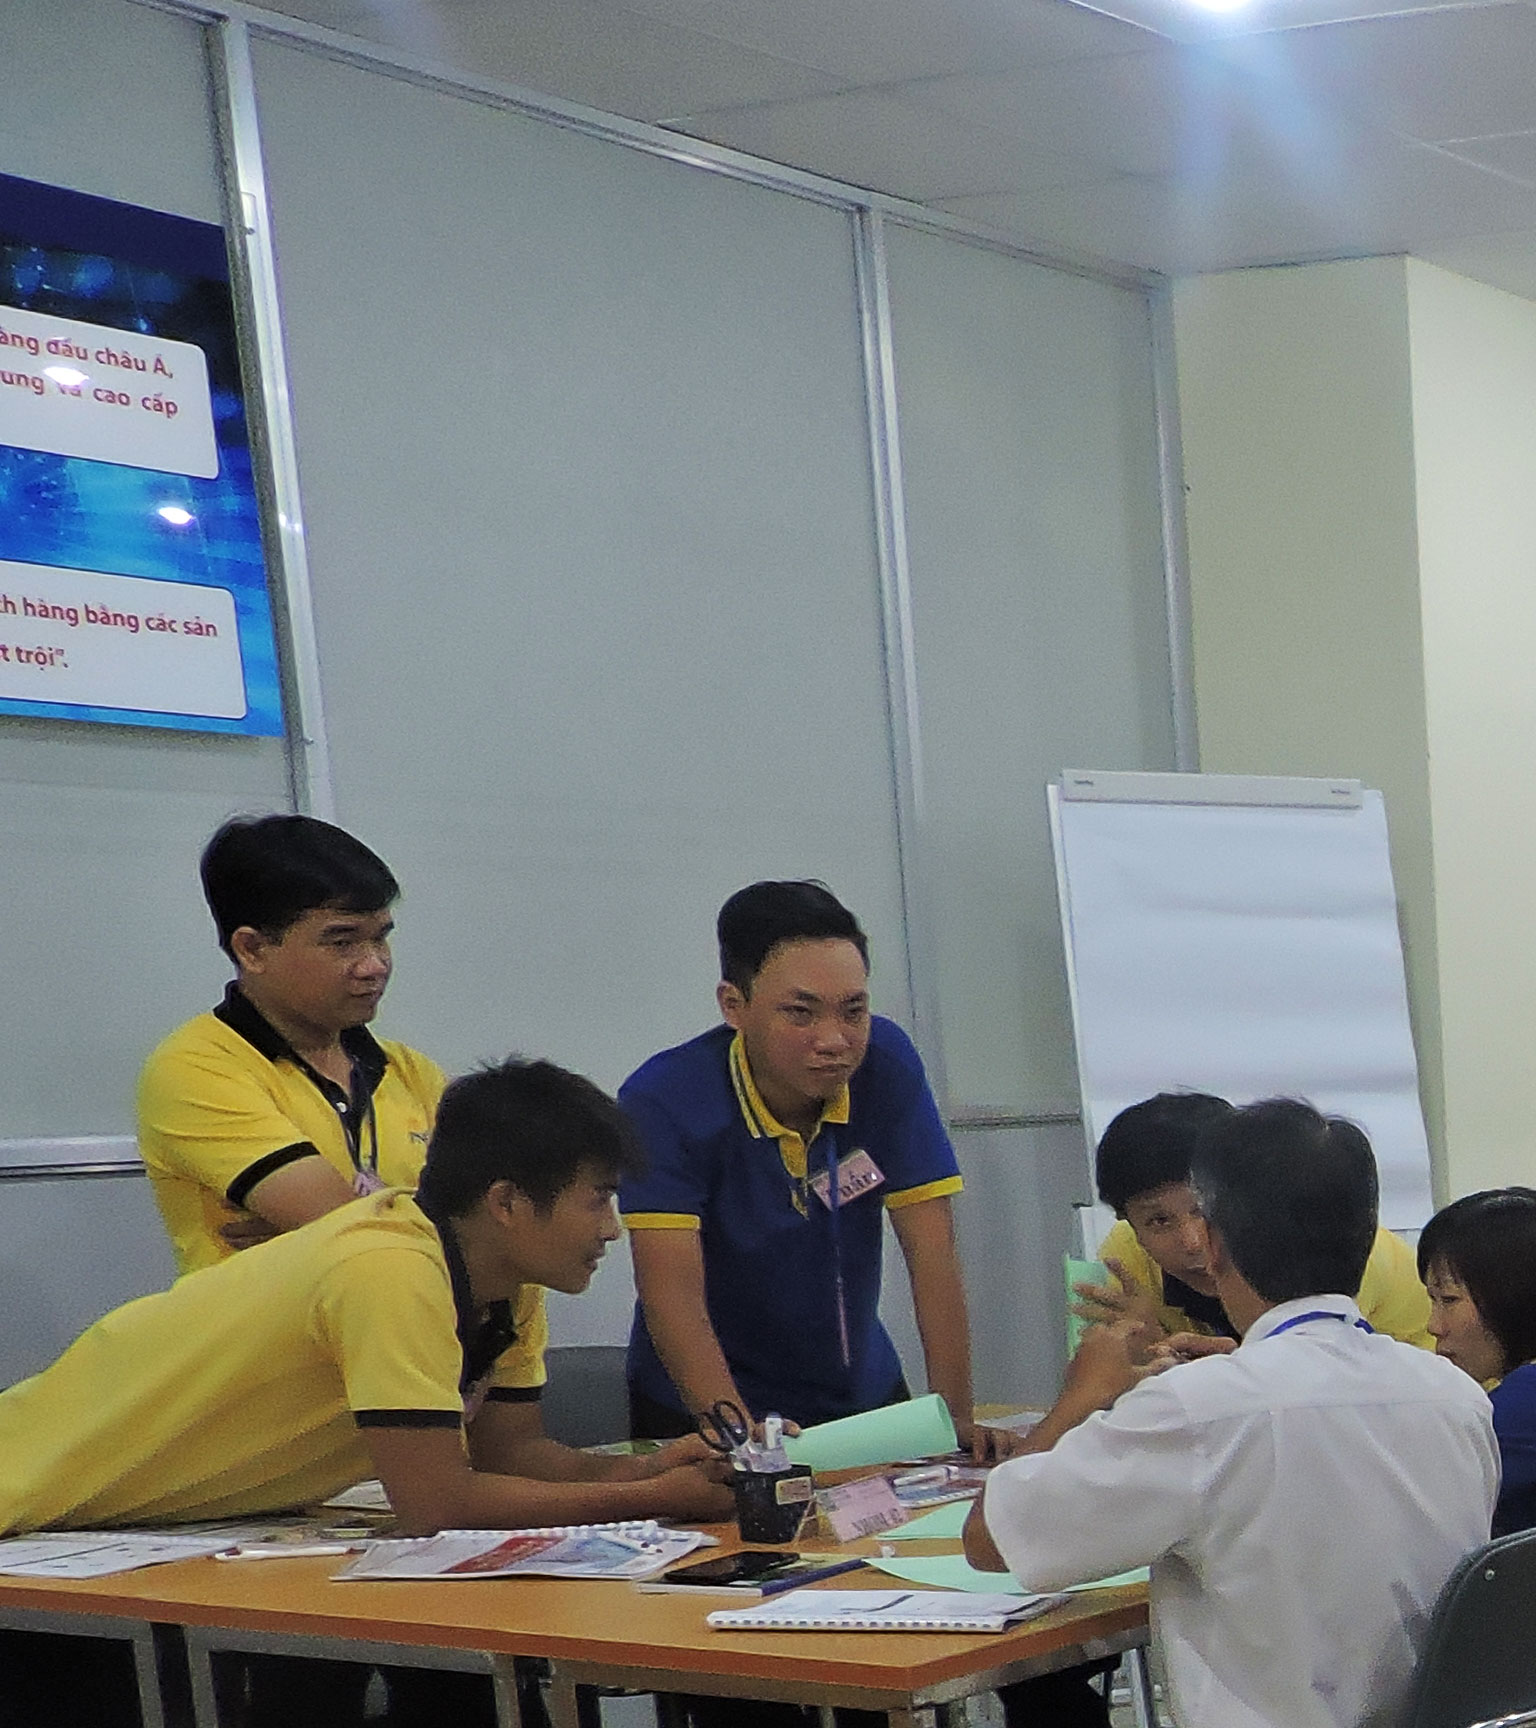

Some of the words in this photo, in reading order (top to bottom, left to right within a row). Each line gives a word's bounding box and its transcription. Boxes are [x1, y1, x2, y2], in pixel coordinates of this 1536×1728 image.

[95, 347, 147, 373] châu
[93, 387, 131, 407] cao
[22, 597, 80, 628] hàng
[145, 612, 178, 634] các
[183, 615, 219, 638] sản
